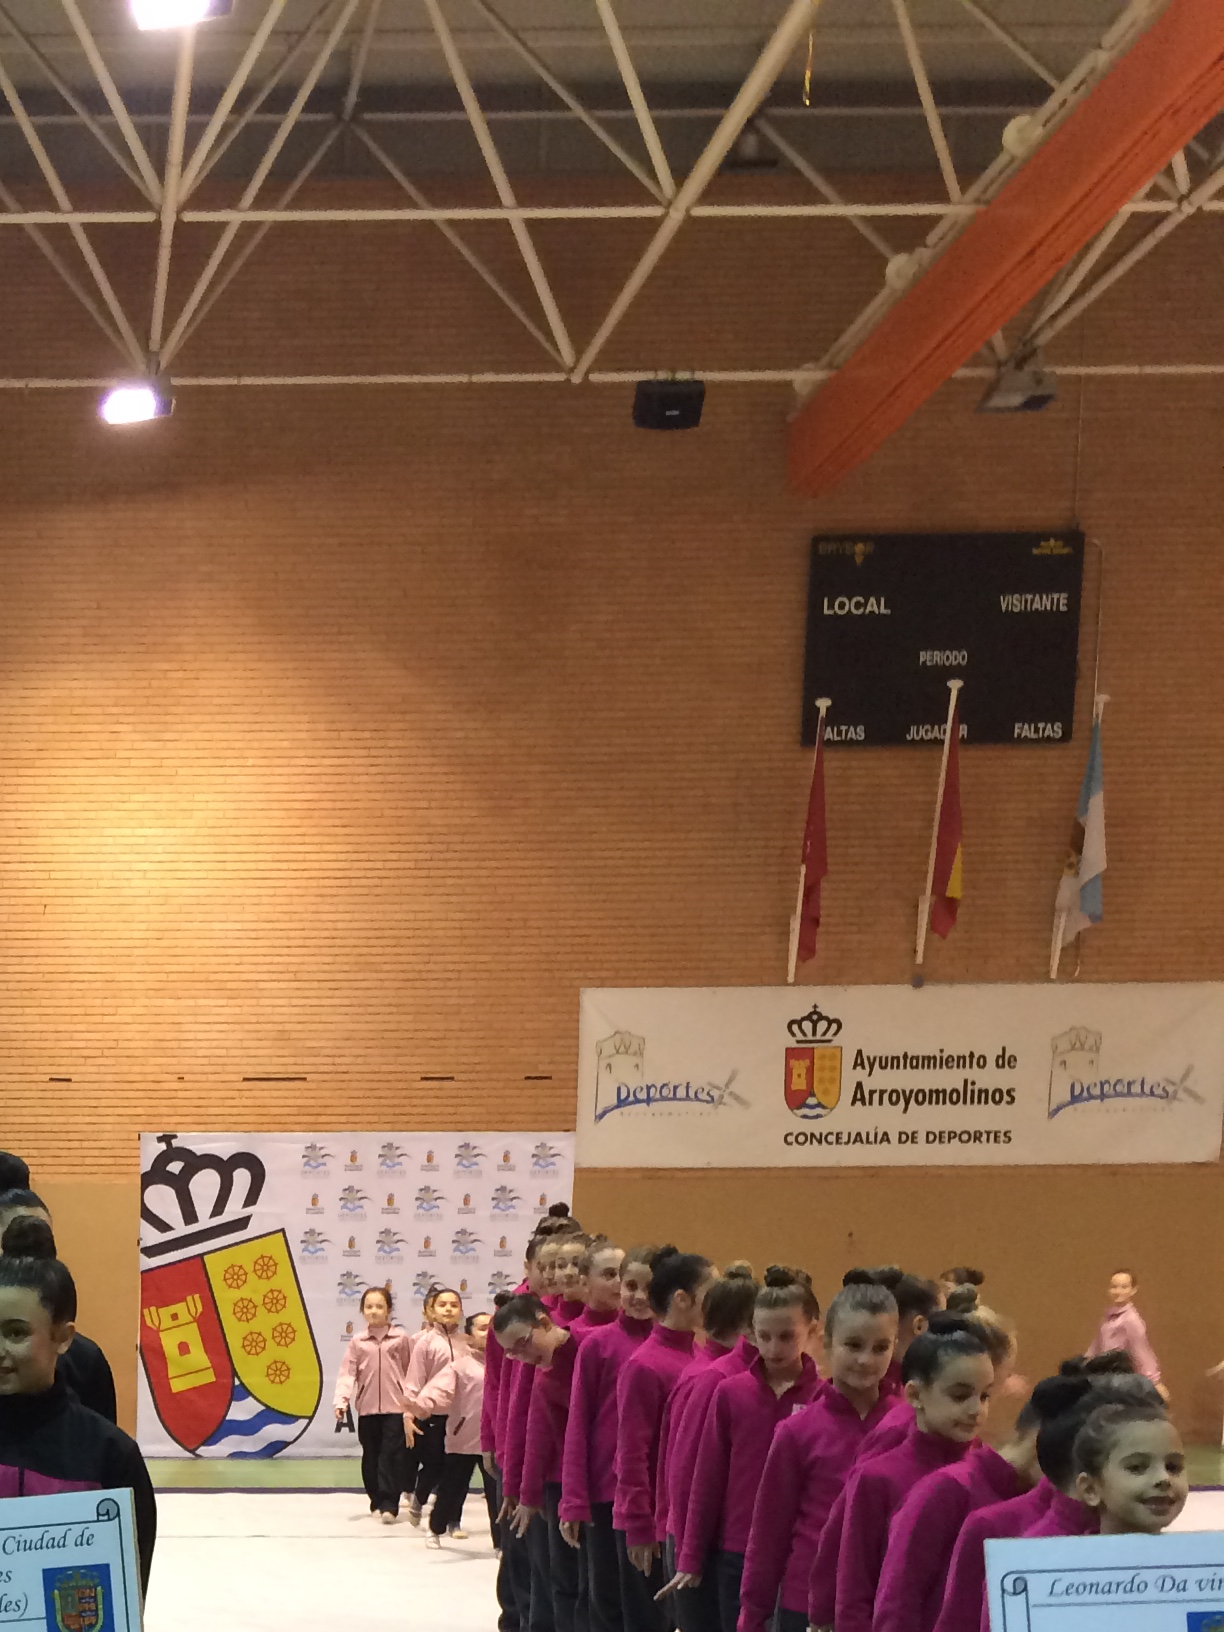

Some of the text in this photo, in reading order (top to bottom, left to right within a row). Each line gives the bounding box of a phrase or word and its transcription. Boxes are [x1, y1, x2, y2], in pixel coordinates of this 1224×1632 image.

[823, 596, 891, 615] LOCAL
[1000, 592, 1069, 613] VISITANTE
[919, 650, 968, 666] PERIODO
[823, 724, 865, 741] ALTAS
[906, 723, 968, 741] JUGADR
[1014, 722, 1063, 739] FALTAS
[852, 1045, 1018, 1078] Ayuntamiento de
[850, 1078, 1016, 1114] Arroyomolinos
[783, 1126, 1013, 1146] CONCEJALÍA DE DEPORTES
[1, 1528, 72, 1556] Ciudad
[73, 1526, 95, 1548] de
[1047, 1572, 1149, 1597] Leonardo
[1154, 1574, 1189, 1594] Da
